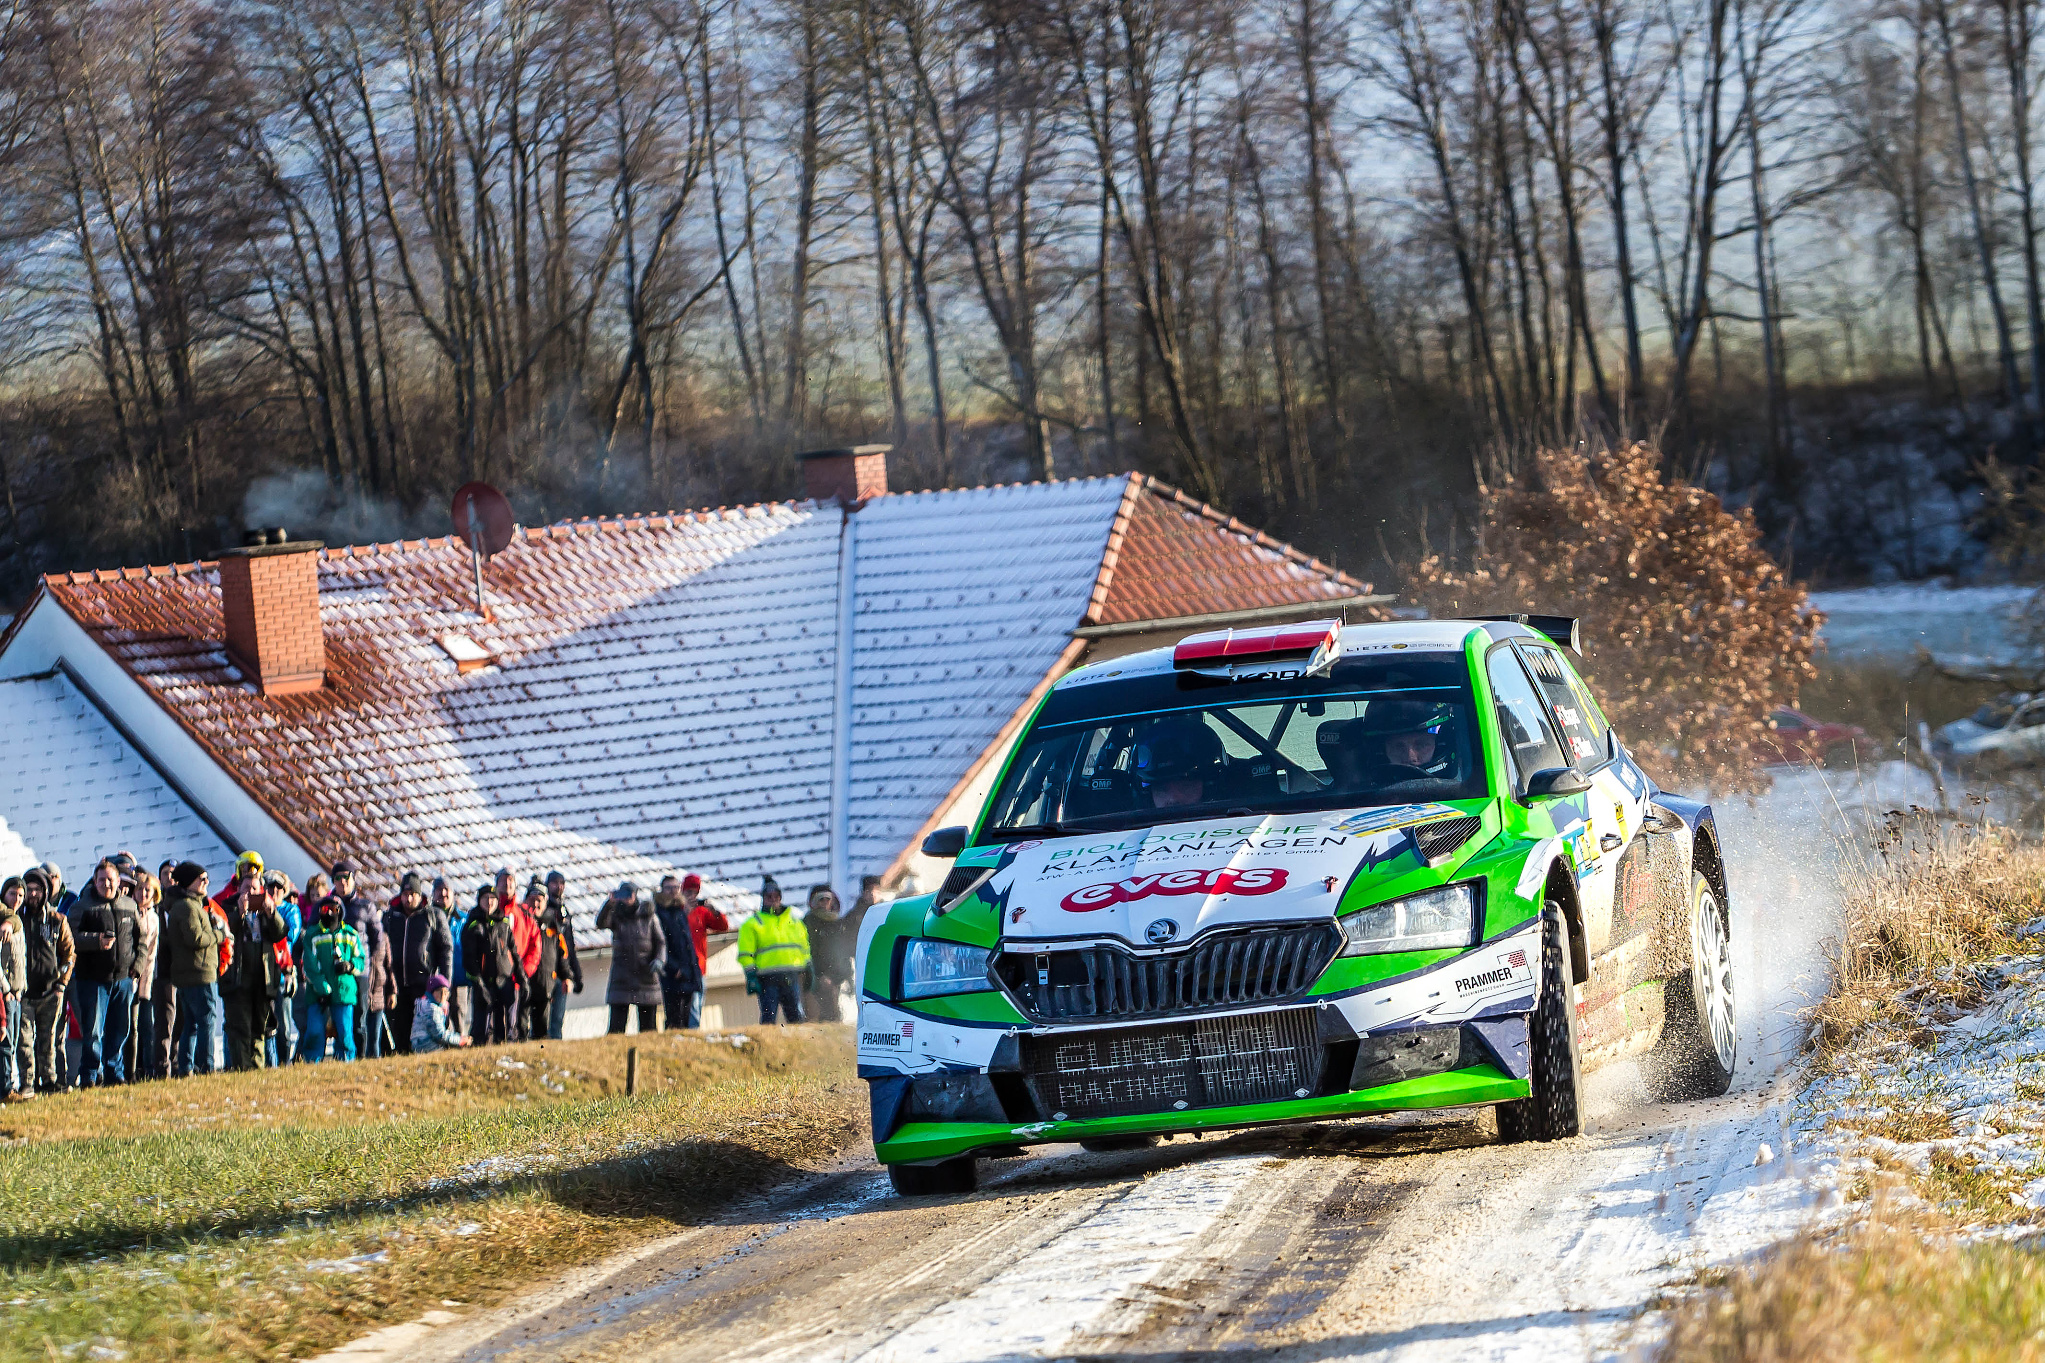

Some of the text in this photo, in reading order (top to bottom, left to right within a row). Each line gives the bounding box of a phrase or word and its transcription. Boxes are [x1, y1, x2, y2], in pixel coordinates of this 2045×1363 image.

[1346, 644, 1389, 653] LIETZ
[1319, 734, 1340, 742] OMP
[1251, 764, 1272, 775] OMP
[1091, 779, 1112, 789] OMP
[1051, 824, 1318, 861] BIOLOGISCHE
[1067, 867, 1278, 906] evers
[1455, 967, 1513, 992] PRAMMER
[862, 1032, 901, 1046] PRAMMER
[1058, 1060, 1297, 1107] RACING TEAM
